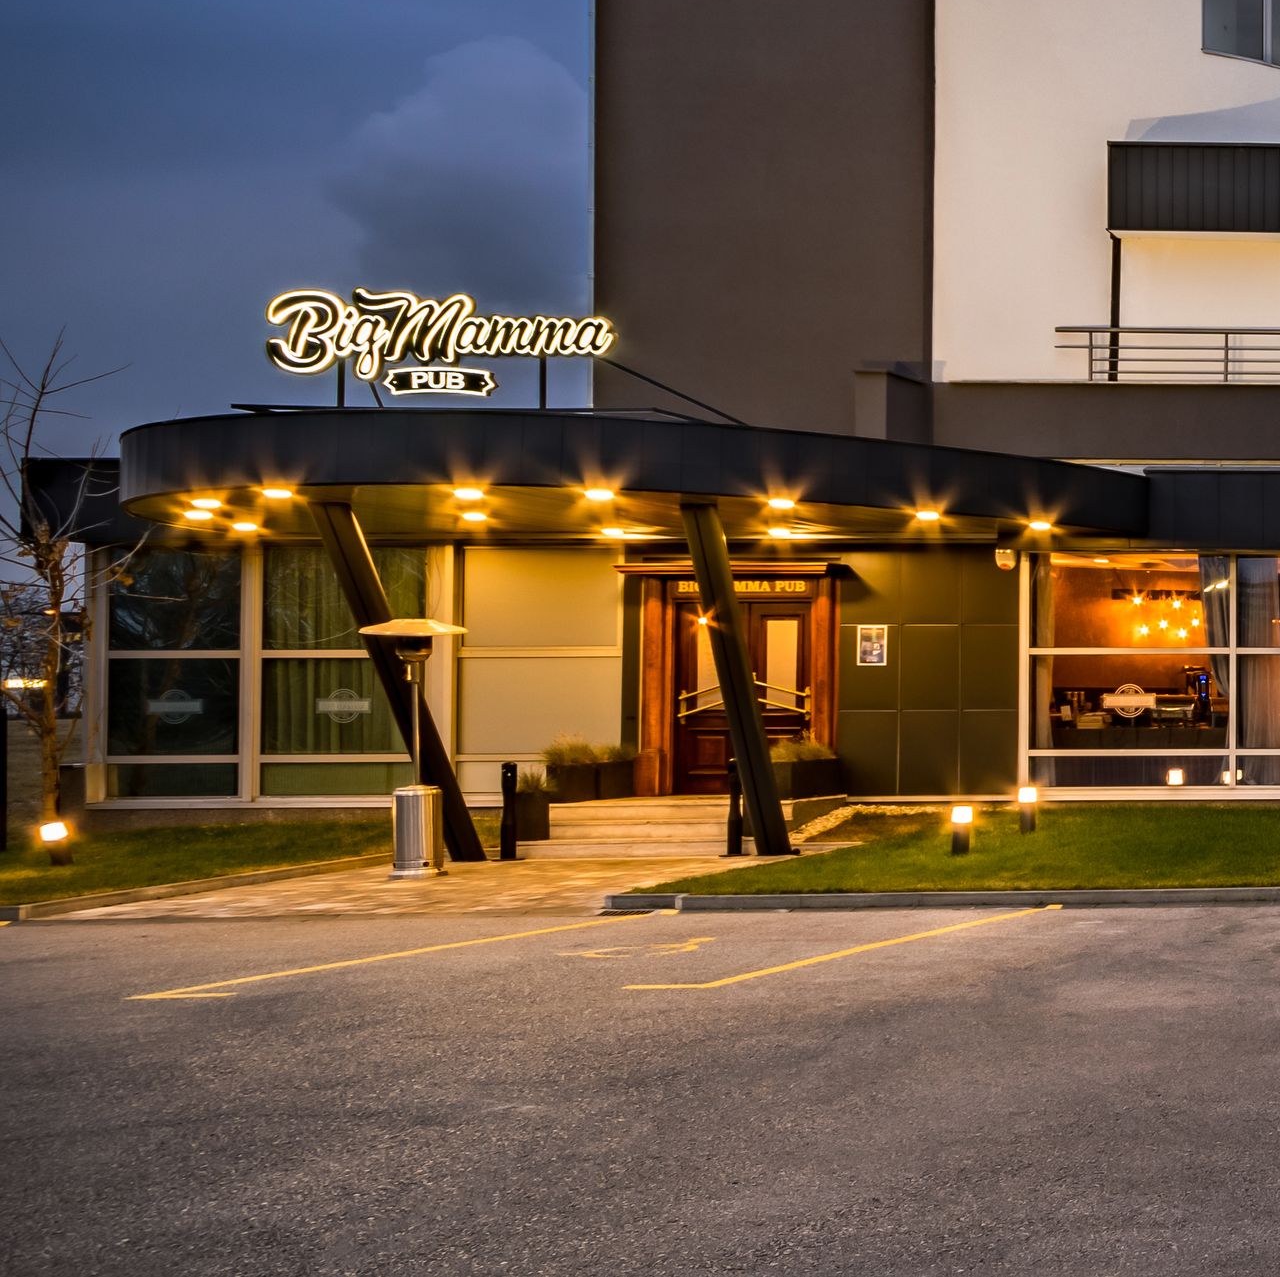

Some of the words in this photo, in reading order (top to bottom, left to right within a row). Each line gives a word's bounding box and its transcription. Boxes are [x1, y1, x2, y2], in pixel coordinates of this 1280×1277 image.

[266, 289, 390, 381] Big
[353, 287, 617, 366] Mamma
[411, 371, 465, 390] PUB
[774, 581, 806, 592] PUB
